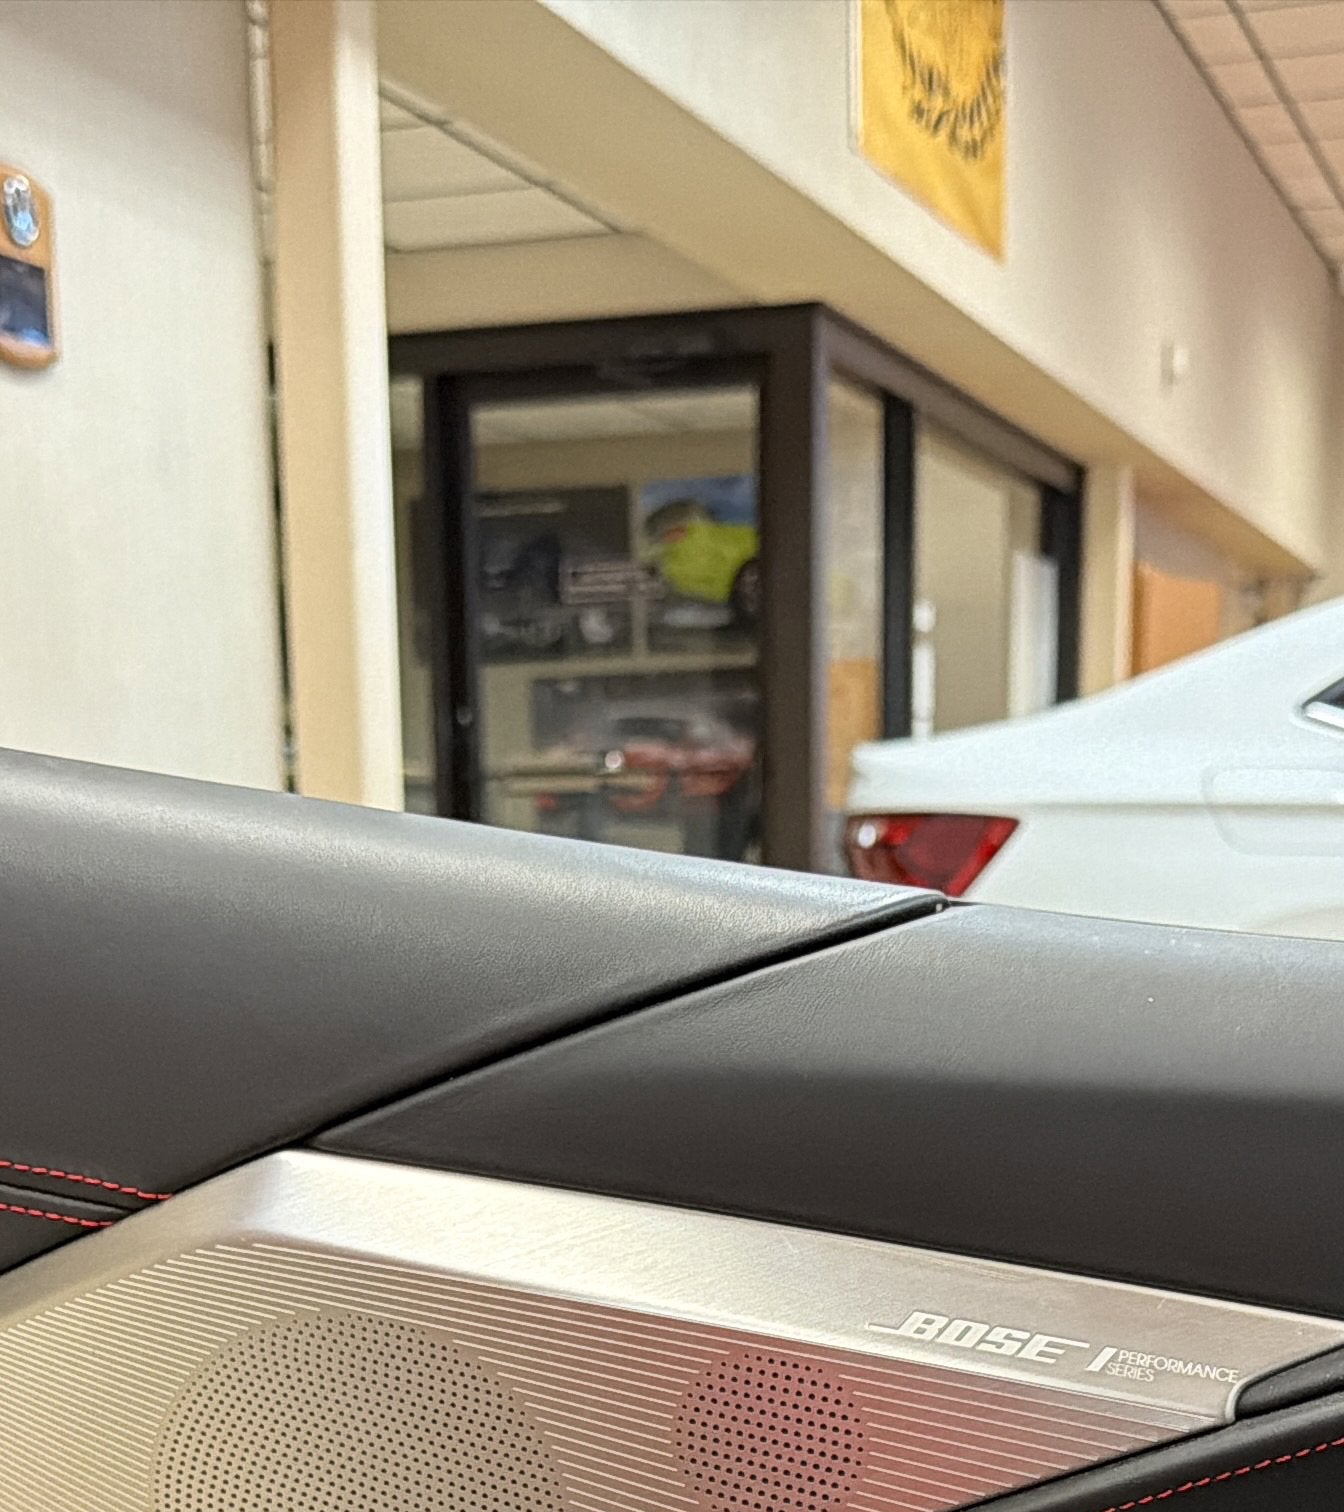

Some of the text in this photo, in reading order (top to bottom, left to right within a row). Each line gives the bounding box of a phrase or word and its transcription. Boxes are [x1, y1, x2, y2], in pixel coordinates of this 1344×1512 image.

[867, 1311, 1090, 1364] BOSE
[1105, 1363, 1154, 1382] SERIES
[1118, 1350, 1239, 1383] PERFORMANCE
